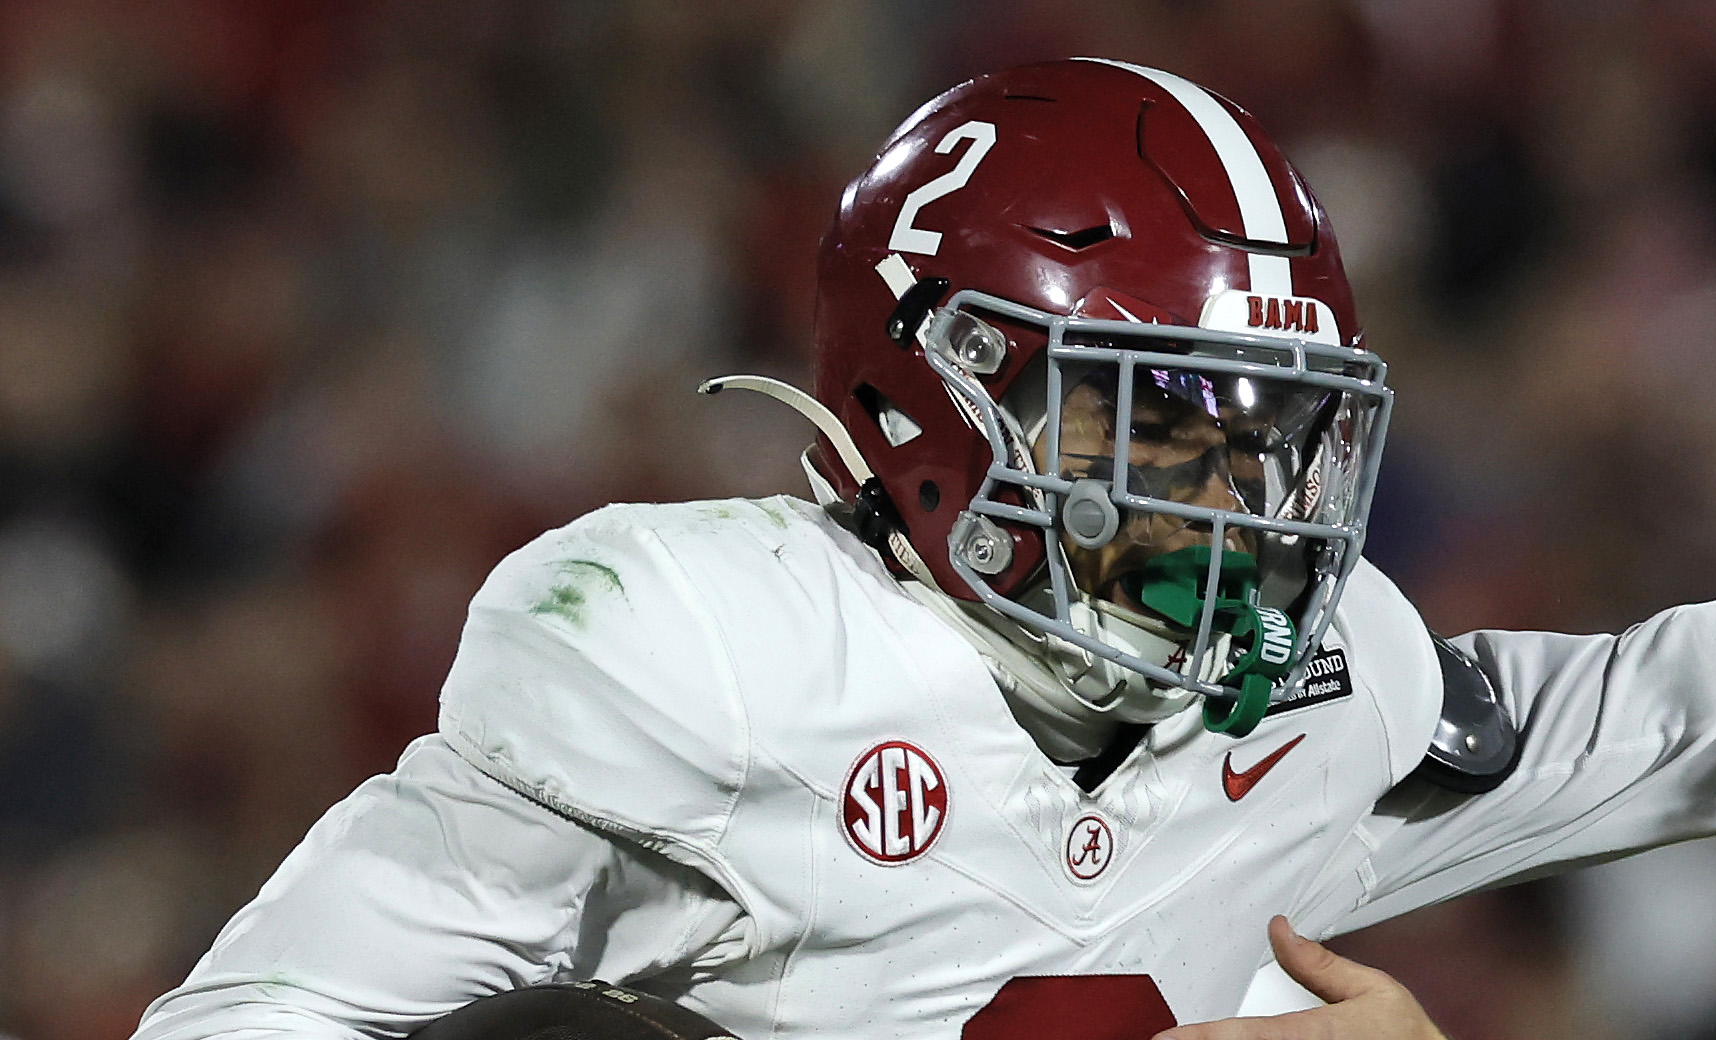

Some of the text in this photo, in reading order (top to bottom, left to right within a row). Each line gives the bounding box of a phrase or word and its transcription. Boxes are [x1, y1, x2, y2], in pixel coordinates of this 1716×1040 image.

[888, 120, 997, 257] 2
[1246, 295, 1320, 335] BAMA
[1257, 605, 1293, 665] RND
[1308, 679, 1341, 698] Allstate
[850, 747, 941, 856] SEC
